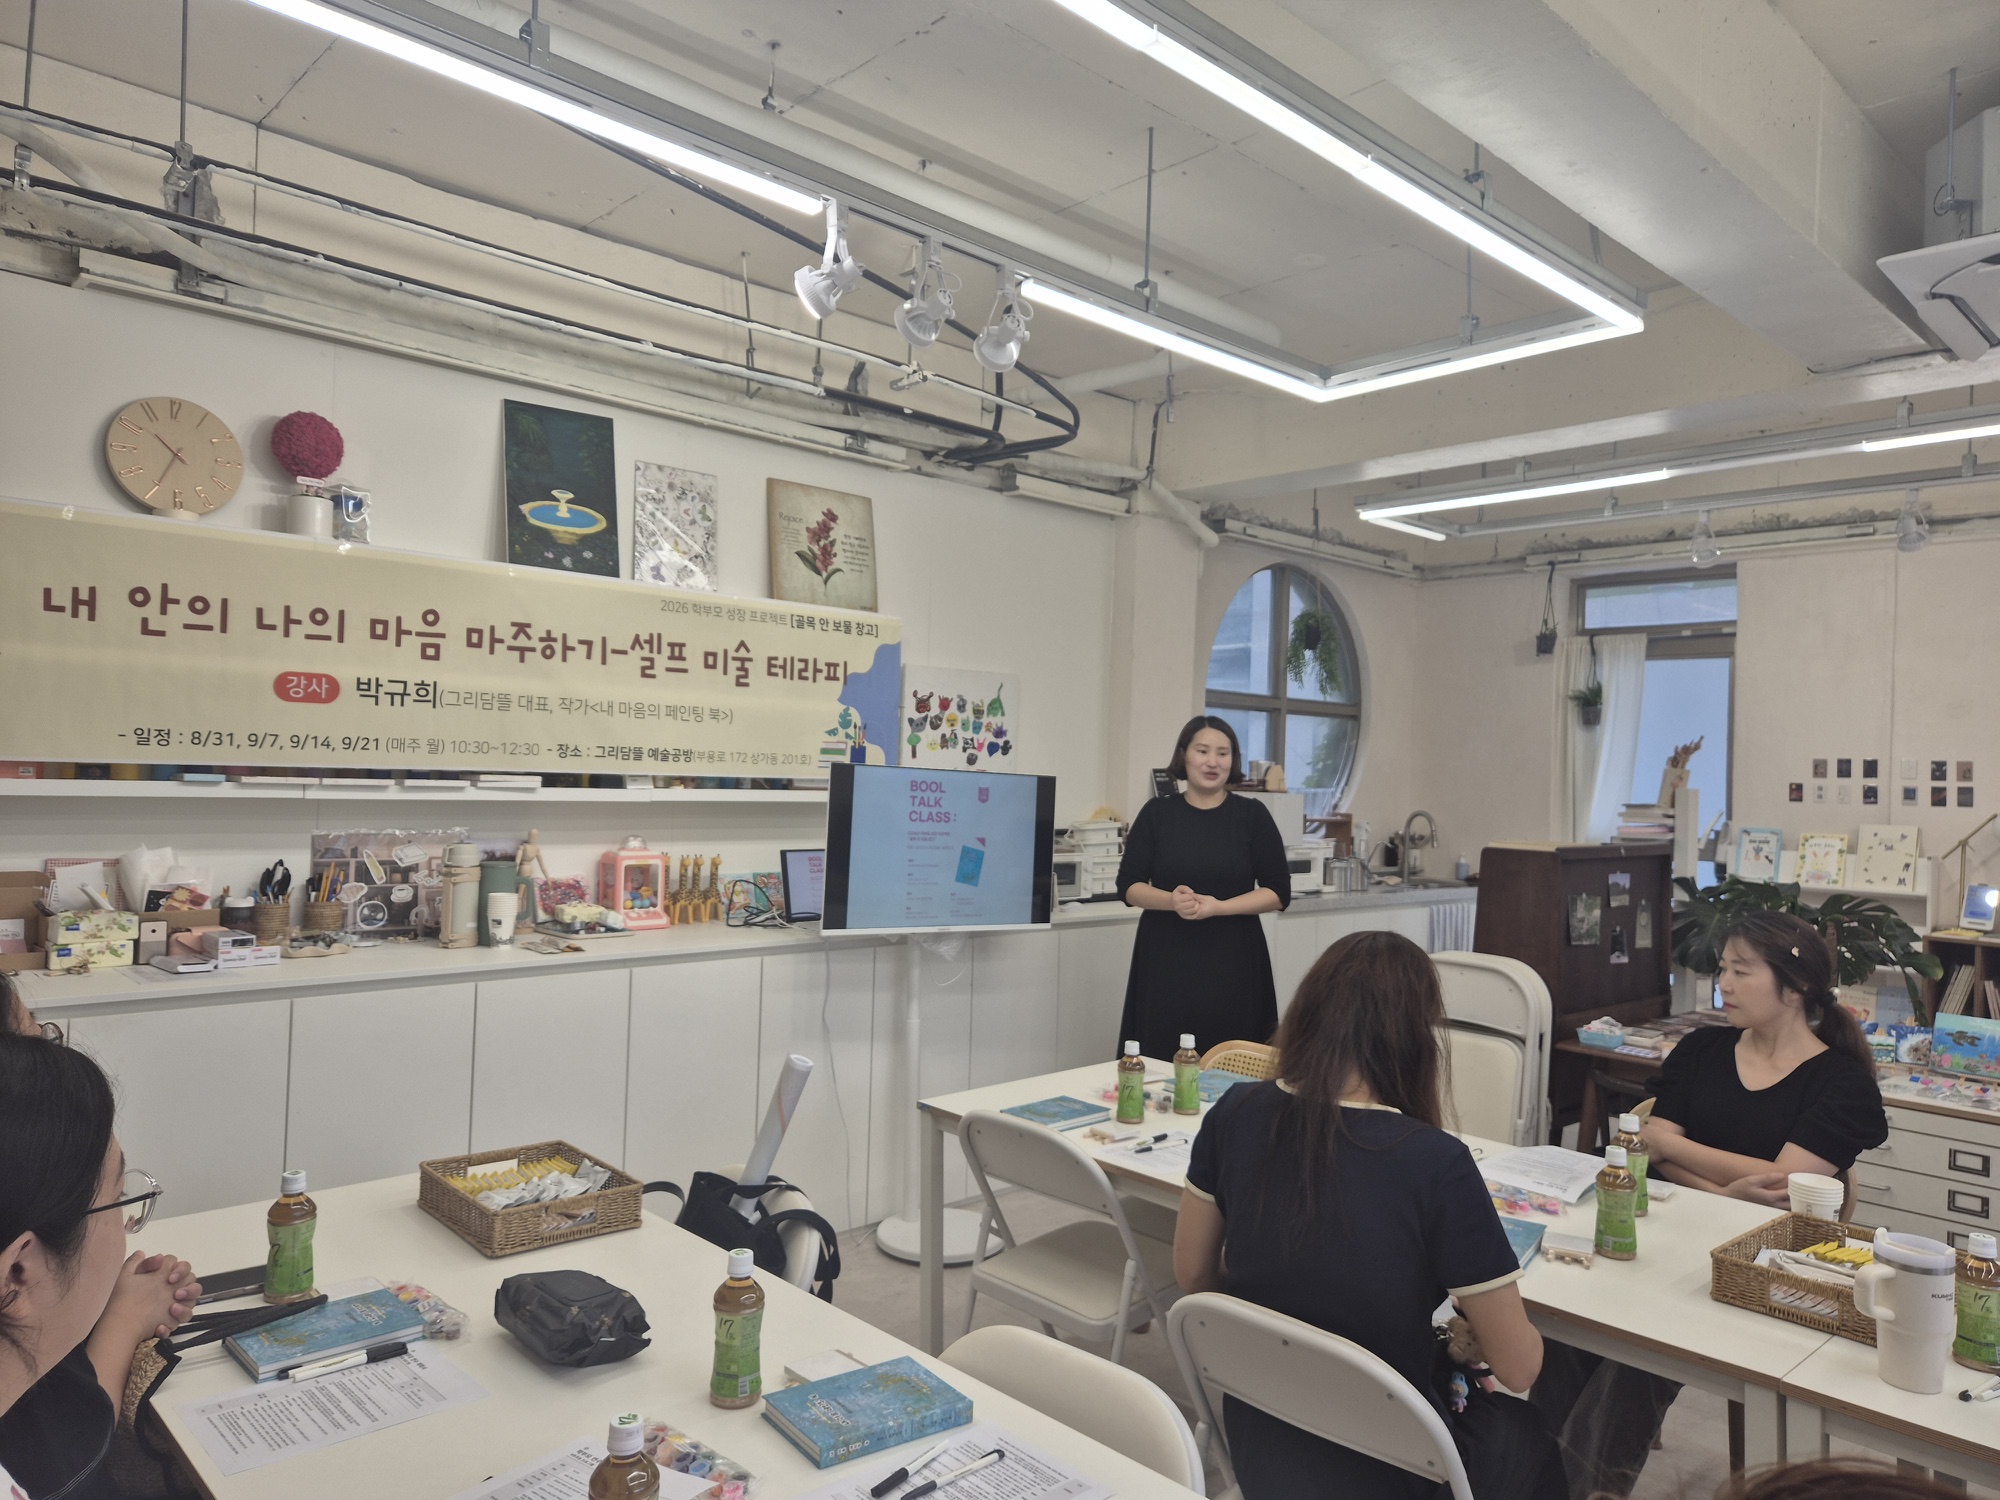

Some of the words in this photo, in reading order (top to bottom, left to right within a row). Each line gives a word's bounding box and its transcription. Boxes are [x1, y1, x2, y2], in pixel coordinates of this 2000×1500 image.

[170, 399, 182, 422] 12
[660, 599, 689, 614] 2026
[691, 604, 723, 618] 학부모
[726, 608, 746, 622] 성장
[748, 610, 788, 626] 프로젝트
[790, 613, 816, 630] [골목
[819, 618, 830, 632] 안
[832, 619, 853, 635] 보물
[855, 621, 879, 638] 창고]
[42, 585, 97, 622] 내
[128, 582, 228, 637] 안의
[255, 605, 345, 643] 나의
[369, 608, 446, 661] 마음
[465, 621, 689, 679] 마주하기-셀프
[703, 639, 753, 688] 미술
[766, 654, 848, 687] 테라피
[285, 675, 329, 699] 강사
[517, 695, 553, 714] 대표,
[558, 696, 614, 717] 작가<내
[618, 701, 661, 720] 마음의
[665, 704, 704, 723] 페인팅
[708, 707, 734, 725] 북>)
[133, 727, 171, 747] 일정
[190, 730, 241, 749] 8/31,
[247, 732, 283, 750] 9/7,
[289, 734, 336, 752] 9/14,
[341, 736, 379, 752] 9/21
[385, 737, 421, 754] (매주
[426, 737, 446, 755] 월)
[450, 739, 540, 756] 10:30~12:30
[556, 743, 582, 759] 장소
[594, 745, 644, 761] 그리담뜰
[647, 747, 726, 763] 예술공방(부용로
[730, 752, 748, 763] 172
[750, 752, 778, 765] 상가동
[781, 753, 812, 766] 201호)
[909, 780, 946, 794] BOOL
[909, 795, 943, 808] TALK
[908, 810, 951, 824] CLASS
